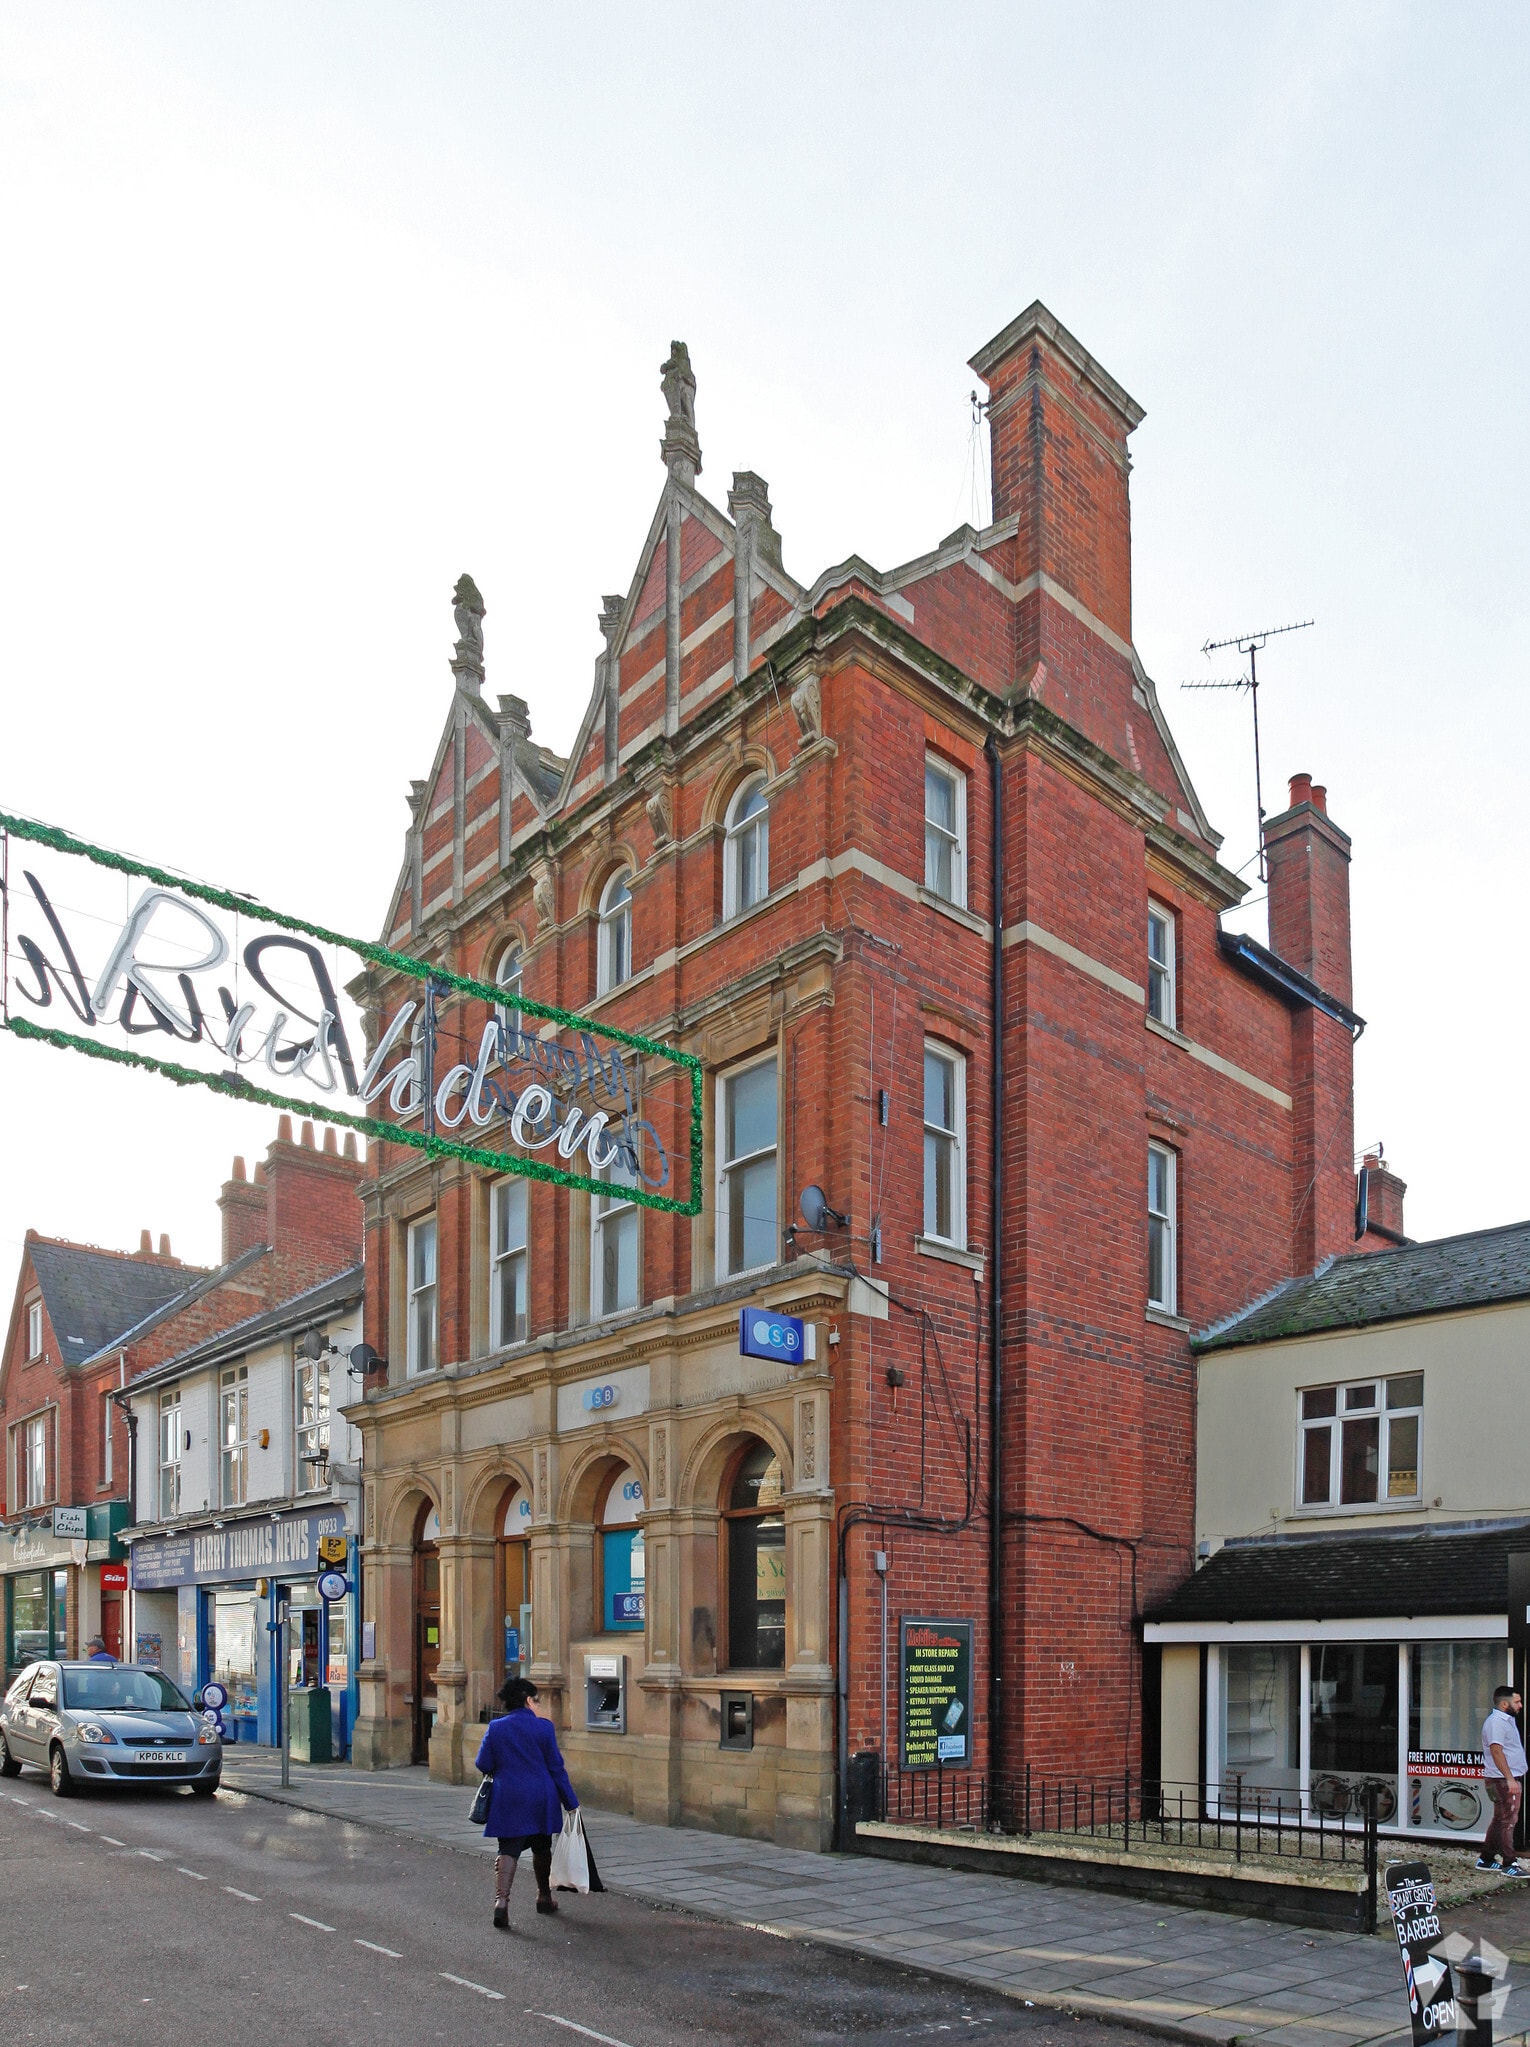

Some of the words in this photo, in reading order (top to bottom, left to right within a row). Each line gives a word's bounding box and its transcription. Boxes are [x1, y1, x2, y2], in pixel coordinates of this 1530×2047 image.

[90, 887, 622, 1170] Rushden
[585, 1387, 612, 1408] SB
[60, 1512, 80, 1521] Fish
[56, 1524, 84, 1533] Chips
[318, 1518, 337, 1534] 01933
[194, 1534, 226, 1573] BARRY
[228, 1526, 272, 1568] THOMAS
[276, 1520, 309, 1562] NEWS
[625, 1598, 644, 1610] TSB
[906, 1628, 938, 1646] Mobiles
[916, 1649, 922, 1657] IN
[922, 1649, 937, 1657] STORE
[938, 1649, 958, 1657] REPAIRS
[910, 1676, 924, 1684] LIQUID
[906, 1742, 925, 1751] Behind
[1408, 1752, 1423, 1762] FREE
[1425, 1752, 1440, 1762] HOT
[1441, 1753, 1465, 1764] TOWEL
[1467, 1754, 1473, 1764] &
[1474, 1754, 1484, 1764] MA
[1408, 1766, 1440, 1774] INCLUDED
[1441, 1767, 1458, 1775] WITH
[1460, 1768, 1476, 1776] OUR
[1404, 1878, 1415, 1887] The
[1392, 1890, 1413, 1910] SMART
[1413, 1887, 1432, 1902] GENTS
[1397, 1915, 1441, 1944] BARBER
[1423, 1998, 1455, 2030] OPEN
